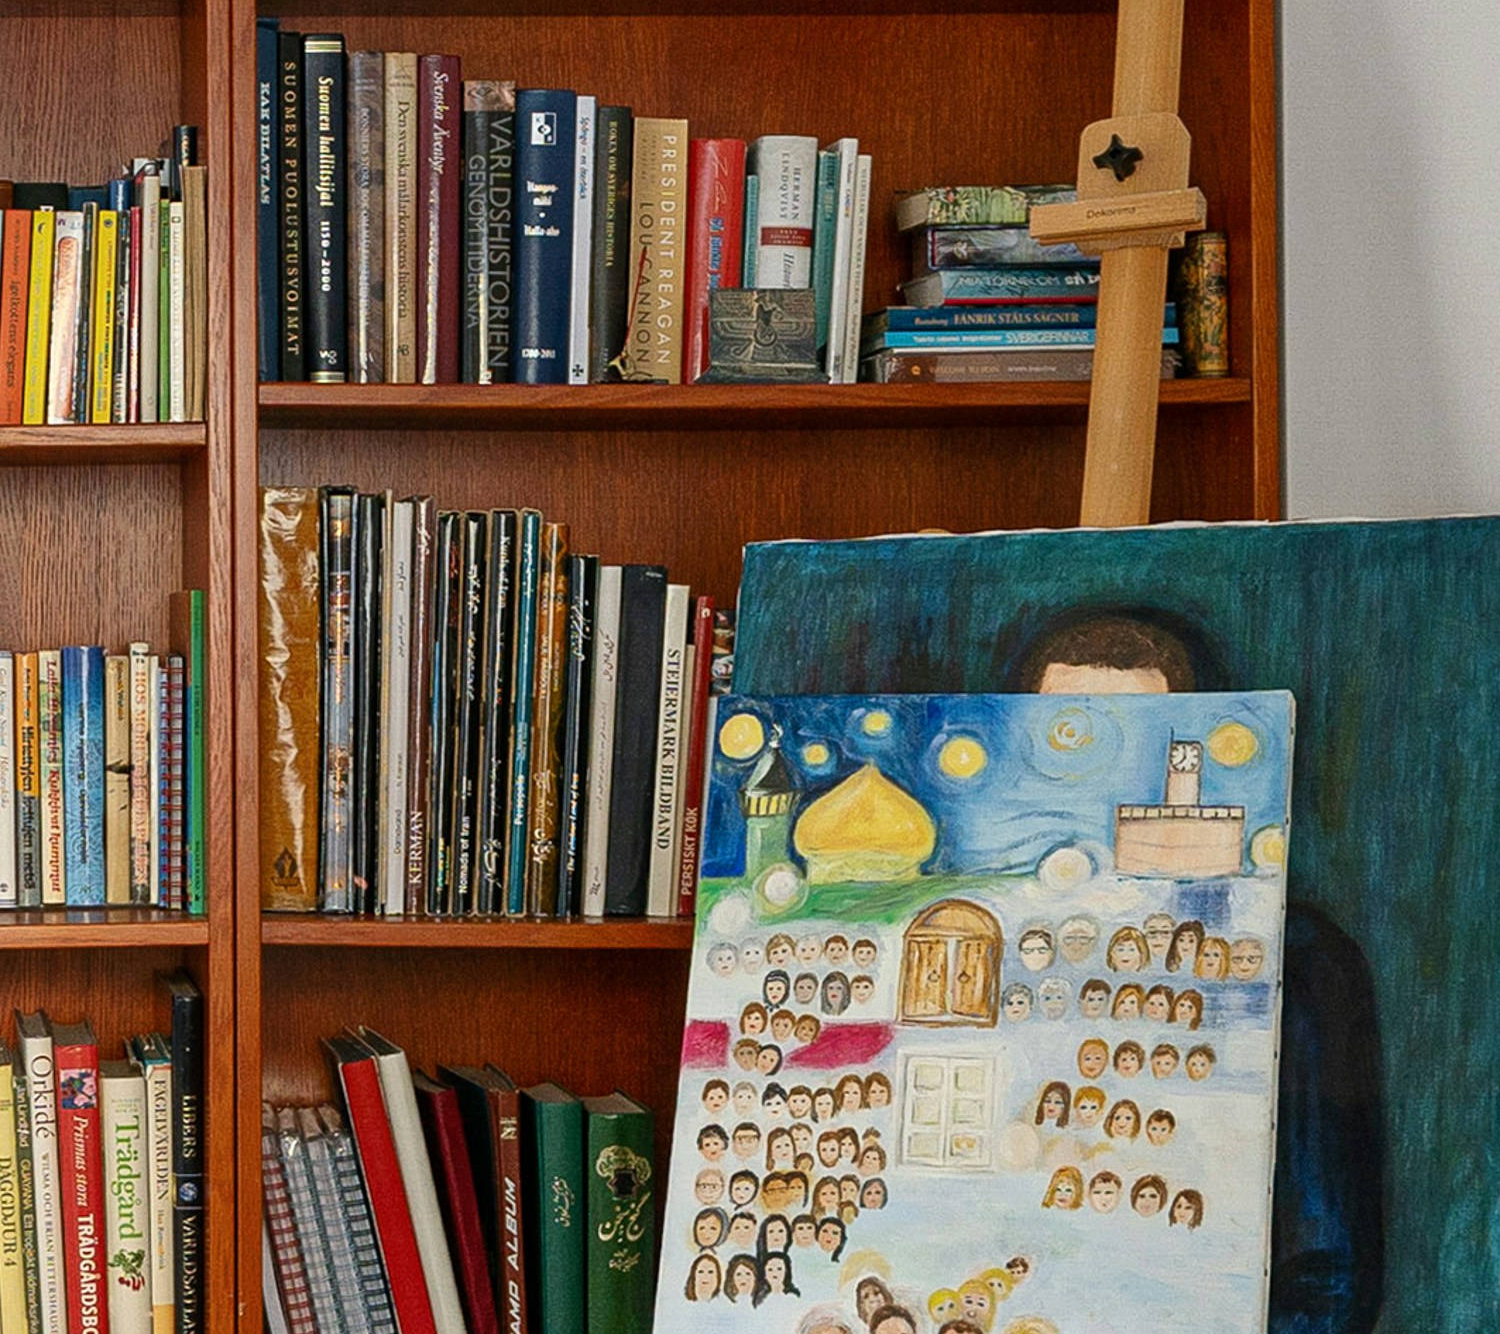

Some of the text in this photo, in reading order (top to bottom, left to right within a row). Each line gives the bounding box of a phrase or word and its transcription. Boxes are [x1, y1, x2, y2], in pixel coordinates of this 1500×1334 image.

[318, 76, 335, 131] Suomen
[432, 71, 452, 174] Svenska Äventyr
[260, 82, 271, 205] KAK BILATLAS
[316, 136, 335, 206] hallitsijat
[284, 62, 299, 355] SUOMEN PUOLUSTUSVOIMAT
[397, 101, 410, 318] Den svenska målarkonstens historia
[605, 121, 617, 267] BOKEN OM SVERIGES HISTORIA
[779, 153, 790, 220] LINDQVIST
[791, 168, 802, 220] HERMAN
[467, 155, 486, 328] GENOM TIDERNA
[488, 116, 515, 367] VÄRLDSHISTORIEN
[657, 135, 677, 364] PRESIDENT REAGAN
[636, 202, 653, 362] LOU CANNON
[998, 312, 1031, 324] STÅLS
[655, 649, 680, 850] STEIERMARK BILDBAND
[513, 775, 526, 825] Persepolis
[22, 852, 36, 889] metsä
[408, 810, 424, 884] KERMAN
[459, 816, 471, 894] Nomads of Iran
[681, 807, 699, 896] PERSISKT KÖK
[32, 1055, 55, 1139] Orkidé
[182, 1094, 196, 1158] LIBERS
[41, 1152, 52, 1191] WILMA
[72, 1116, 88, 1171] Prismas
[154, 1079, 170, 1201] FÅGELVÄRLDEN
[20, 1158, 34, 1210] GUAYANA
[43, 1193, 54, 1219] OCH
[76, 1174, 89, 1206] stora
[110, 1116, 143, 1240] Trädgård
[22, 1231, 36, 1268] tropiskt
[23, 1214, 34, 1229] Ett
[45, 1220, 56, 1252] BRIAN
[503, 1177, 518, 1271] ALBUM
[4, 1257, 16, 1267] 4
[25, 1269, 39, 1334] vildmarksrike
